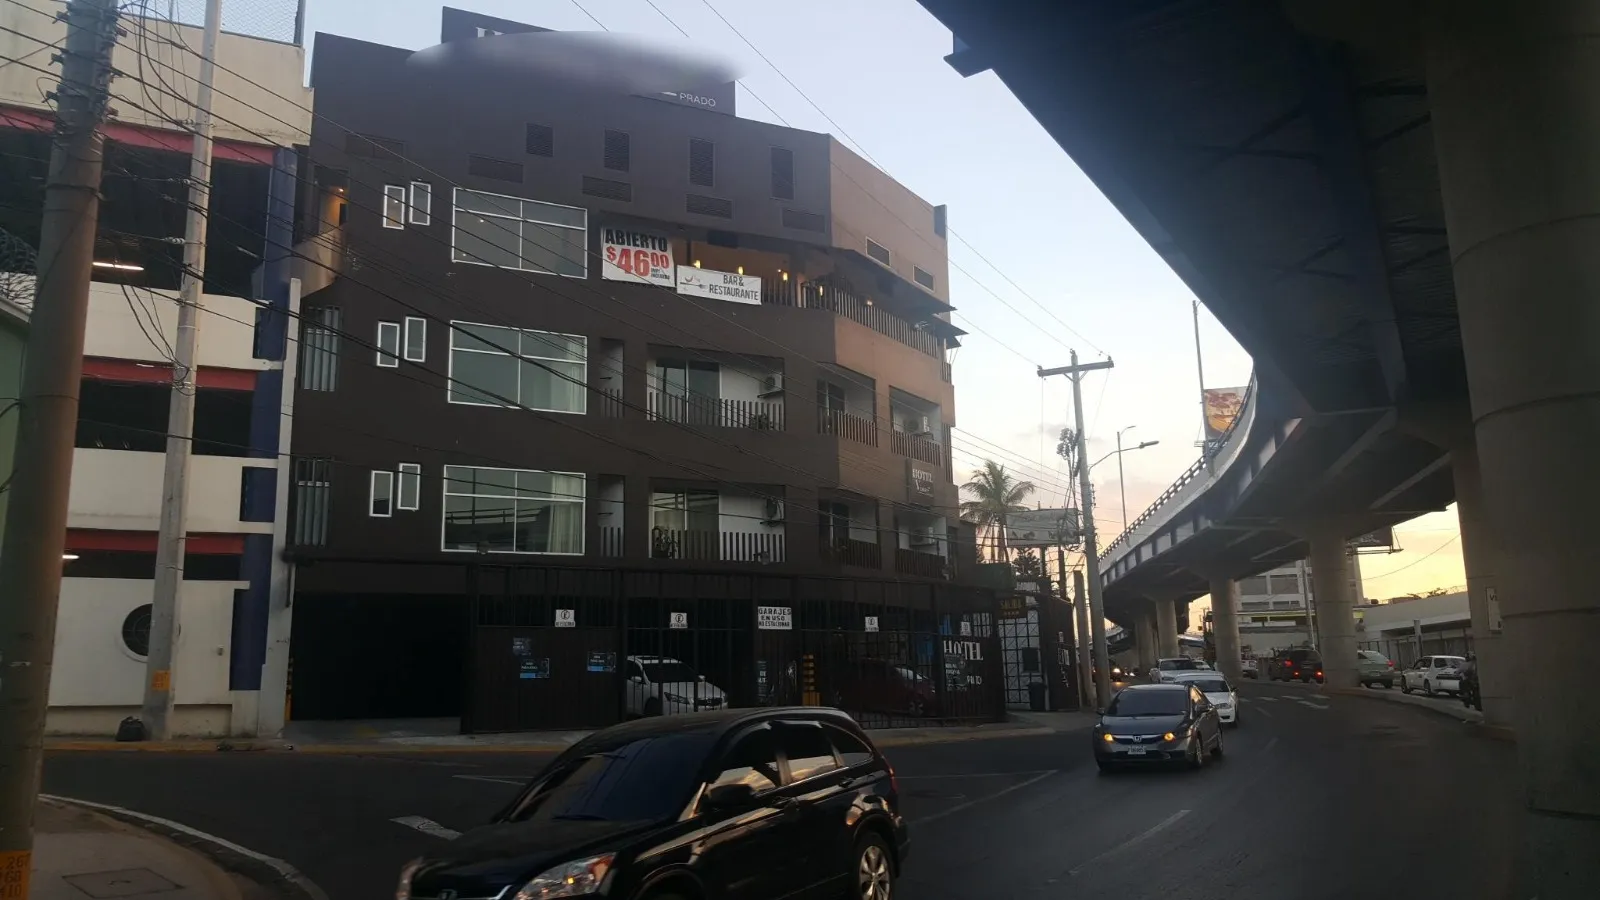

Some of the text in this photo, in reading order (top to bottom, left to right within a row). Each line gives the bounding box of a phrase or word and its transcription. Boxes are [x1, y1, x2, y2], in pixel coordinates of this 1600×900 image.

[679, 92, 716, 108] PRADO
[605, 228, 668, 252] ABIERTO
[709, 284, 759, 301] RESTAURANTE
[943, 640, 984, 660] HOTEL
